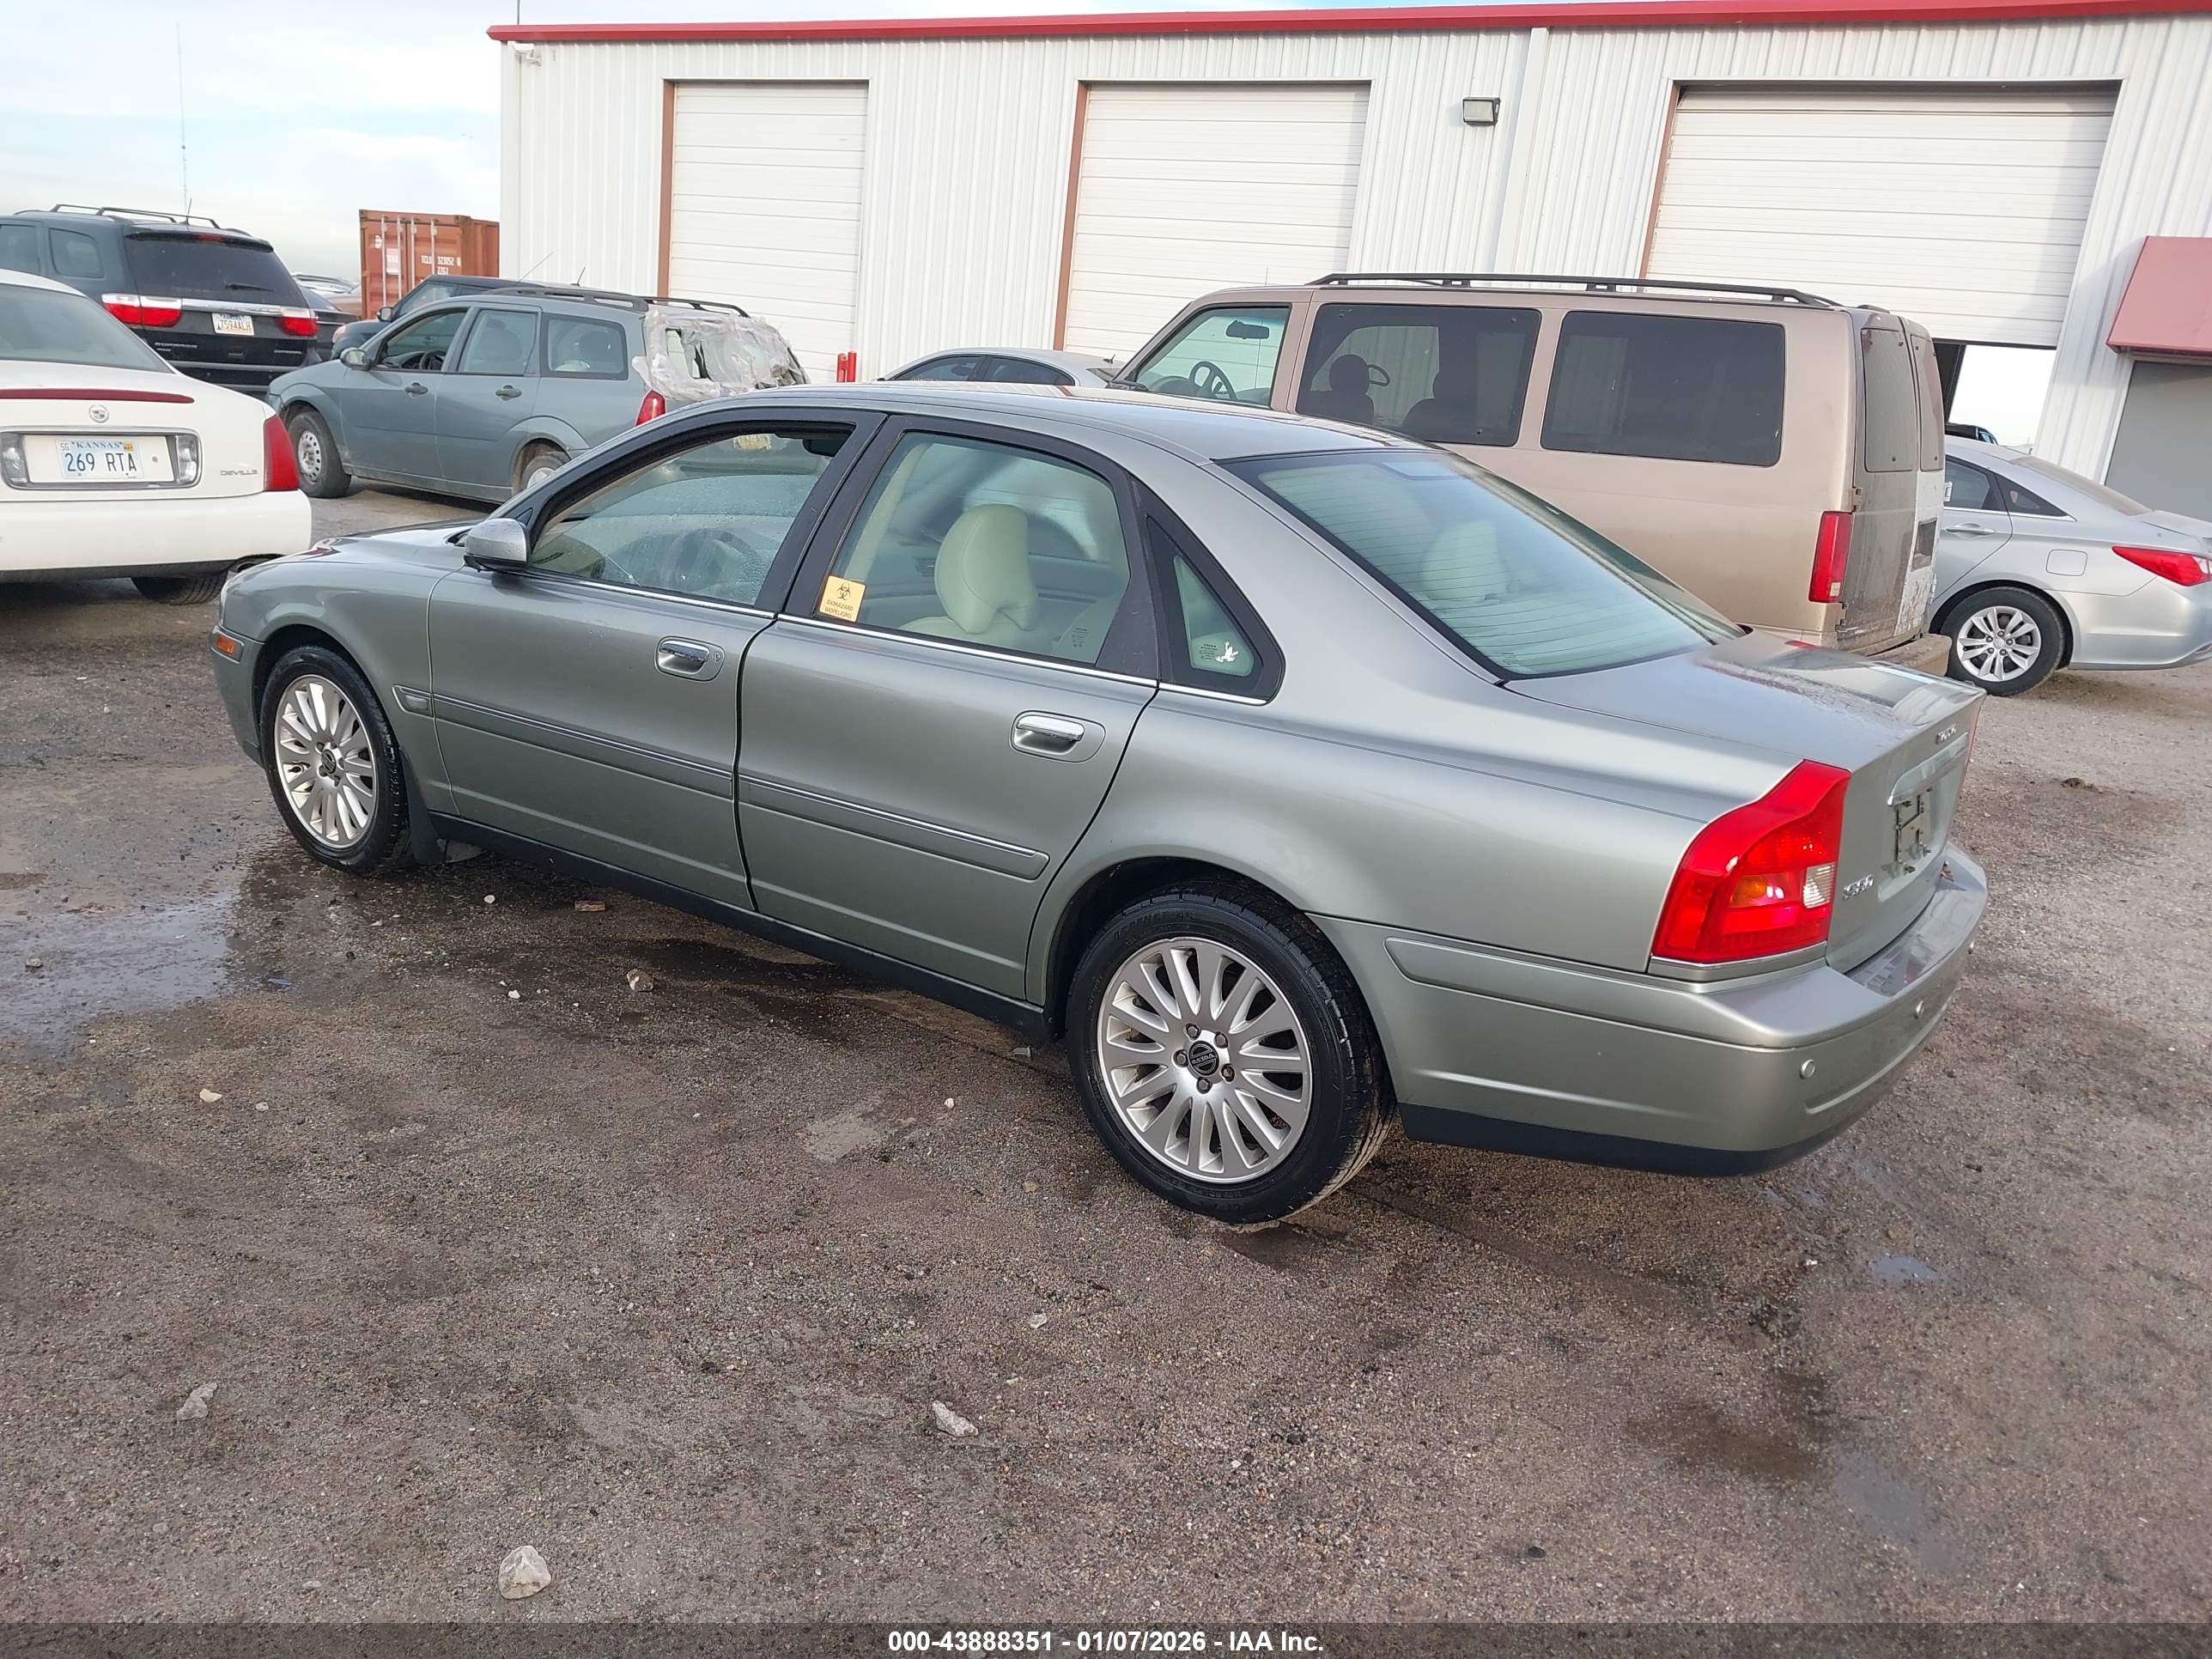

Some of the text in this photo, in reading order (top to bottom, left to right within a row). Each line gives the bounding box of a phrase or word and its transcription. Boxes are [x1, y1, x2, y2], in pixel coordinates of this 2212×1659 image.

[76, 441, 120, 449] KANSAS
[64, 453, 137, 471] 269 RTA
